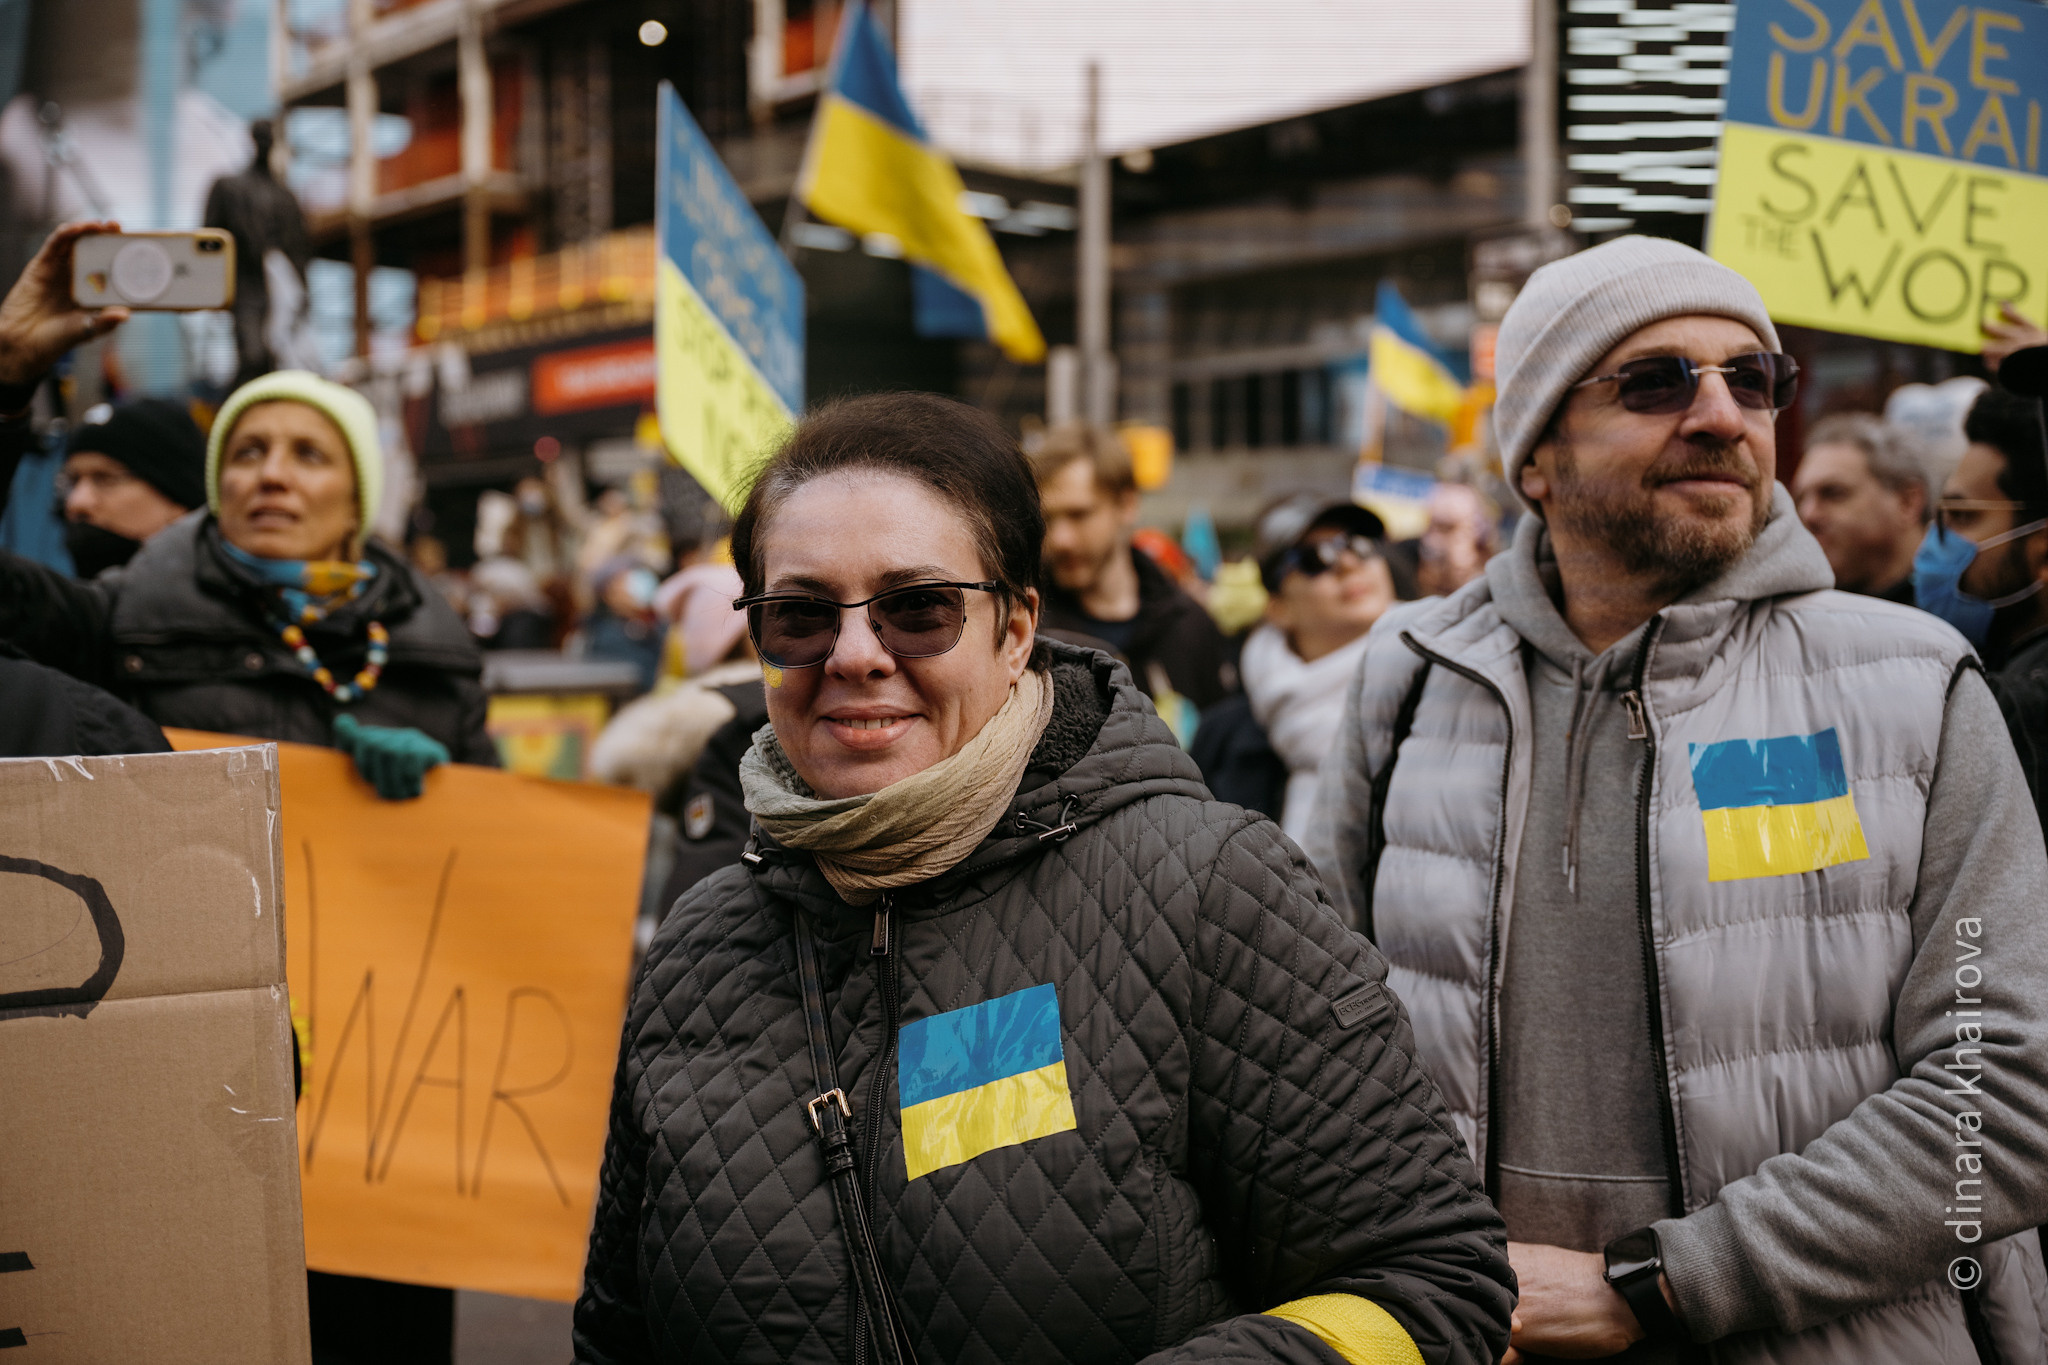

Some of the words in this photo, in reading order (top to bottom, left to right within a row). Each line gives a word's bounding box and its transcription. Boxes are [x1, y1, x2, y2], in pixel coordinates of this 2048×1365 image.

[1769, 0, 2023, 95] SAVE
[1767, 50, 2040, 171] UKRAI
[1759, 142, 2008, 253] SAVE
[303, 838, 572, 1208] WAR
